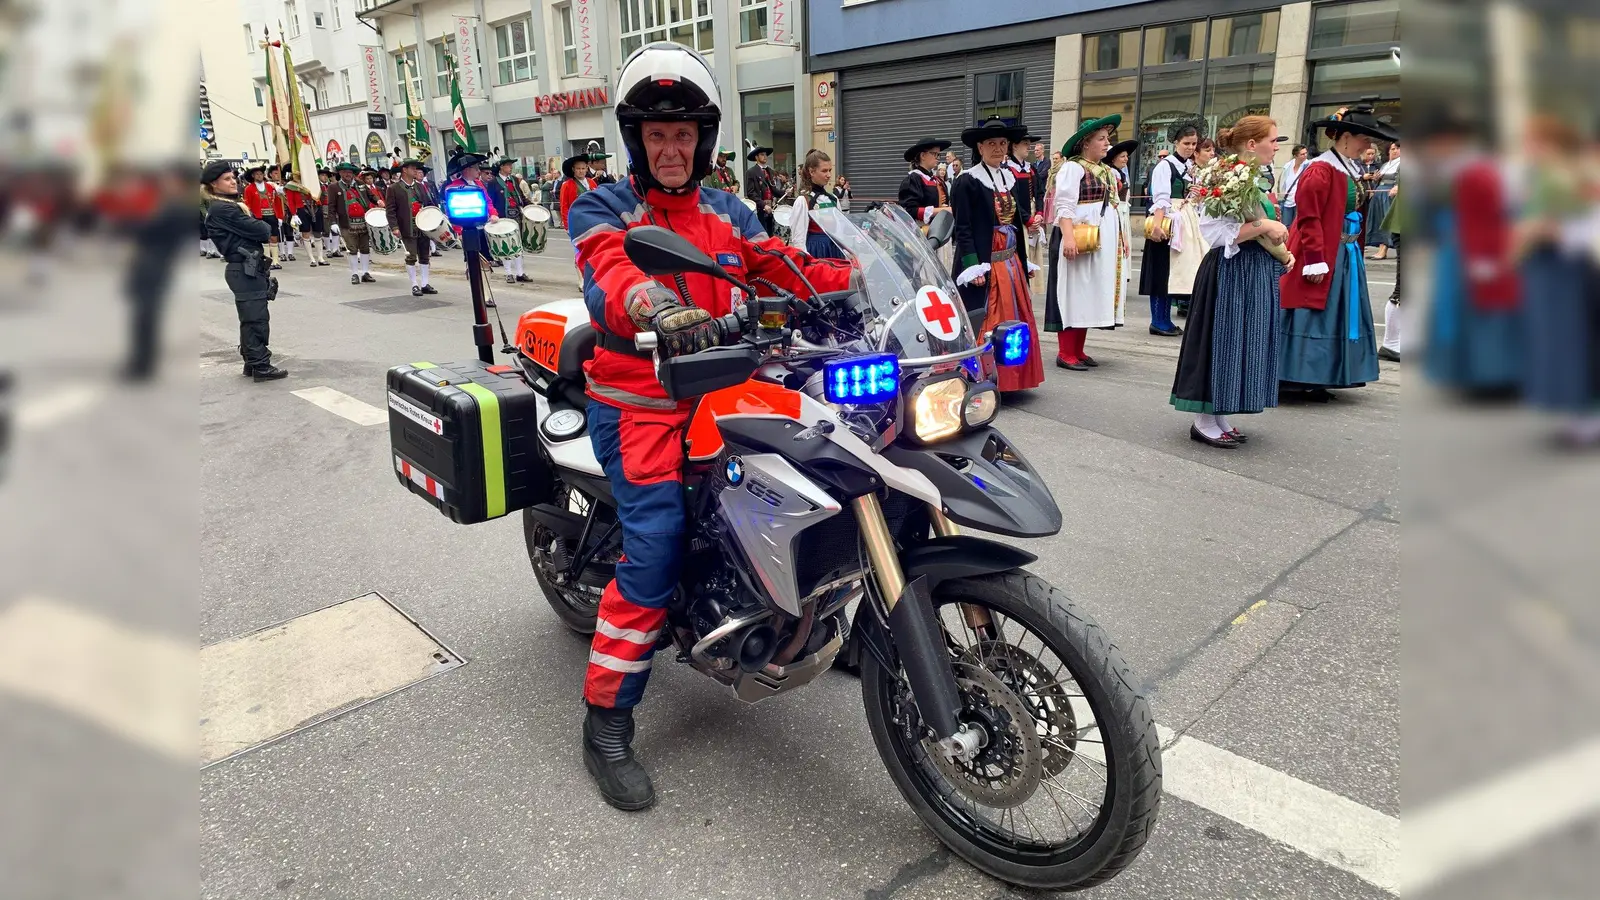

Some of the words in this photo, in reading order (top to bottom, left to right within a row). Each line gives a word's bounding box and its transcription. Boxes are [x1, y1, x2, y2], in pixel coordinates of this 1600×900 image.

[459, 17, 476, 96] ROSSMANN
[365, 47, 380, 112] ROSSMANN
[534, 87, 608, 113] ROSSMANN
[537, 336, 556, 366] 112
[420, 413, 432, 426] Kreuz
[746, 479, 784, 506] GS
